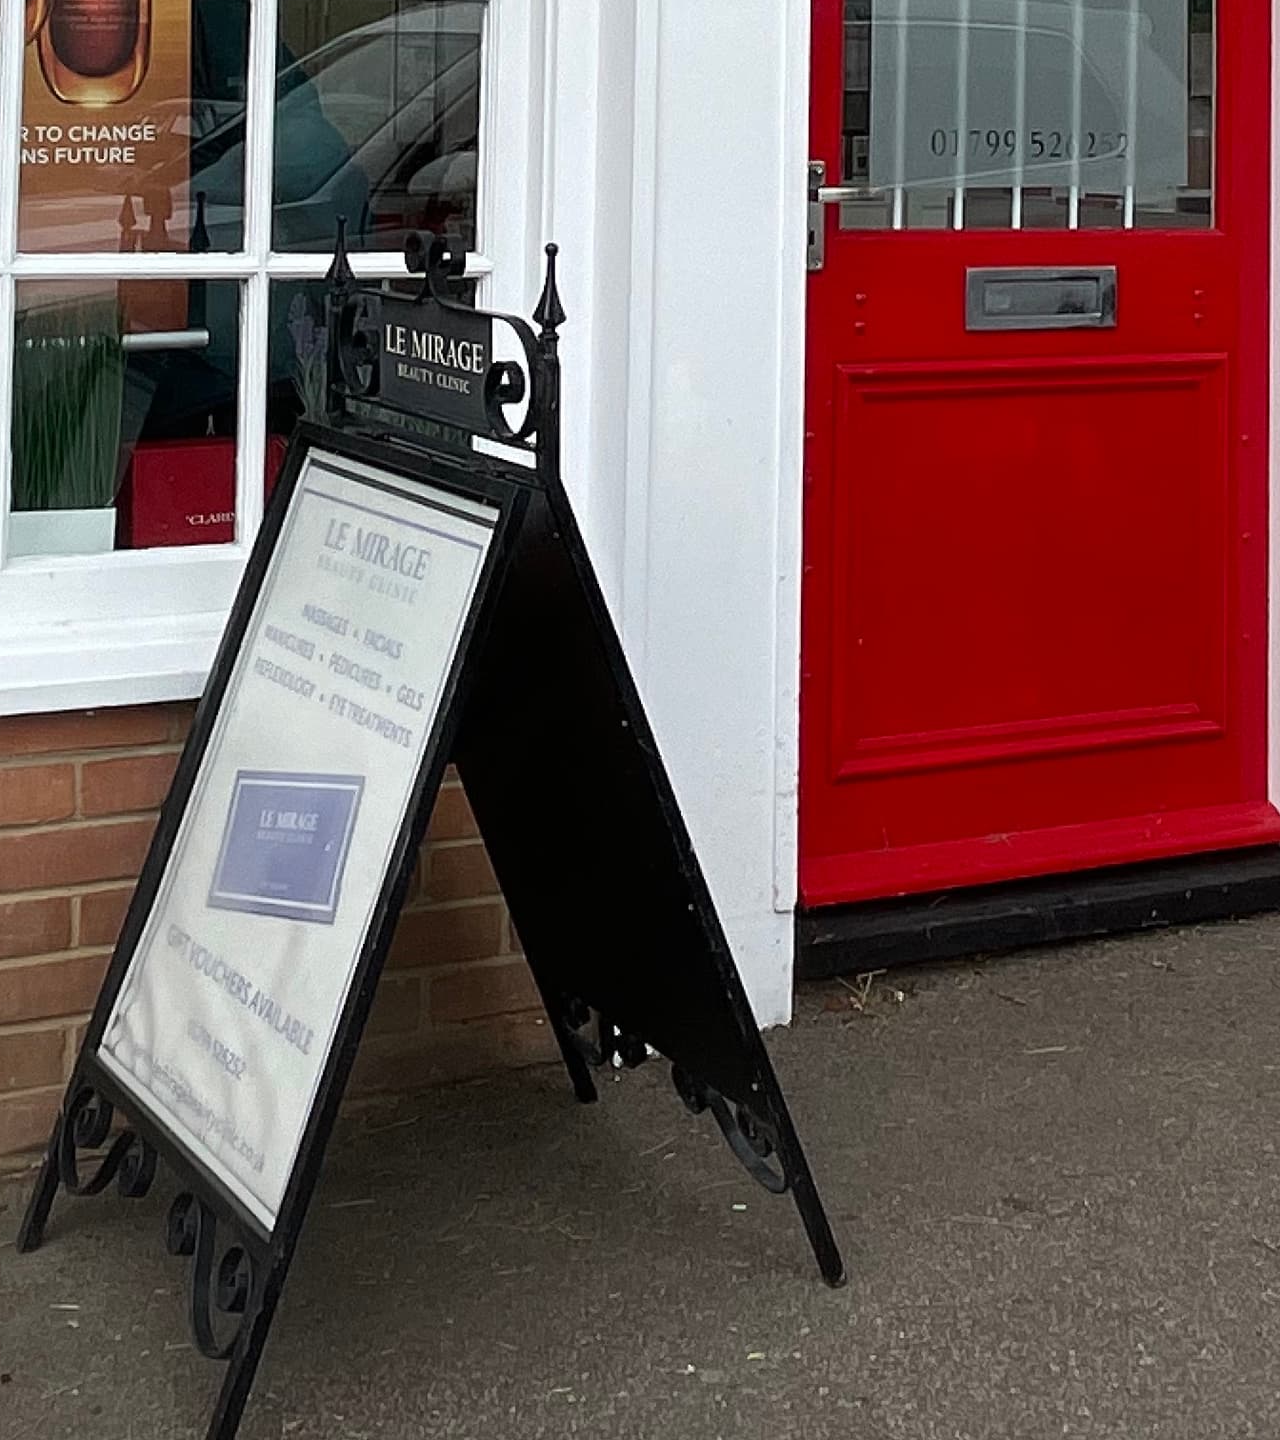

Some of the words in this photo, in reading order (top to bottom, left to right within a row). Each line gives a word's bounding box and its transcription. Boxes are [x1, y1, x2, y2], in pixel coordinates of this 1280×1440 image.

[35, 126, 63, 142] TO
[68, 124, 157, 142] CHANGE
[54, 146, 136, 164] FUTURE
[384, 323, 407, 355] LE
[410, 329, 485, 374] MIRAGE
[397, 361, 434, 385] BEAUTY
[323, 519, 352, 551] LE
[349, 527, 432, 581] MIRAGE
[396, 683, 425, 712] GELS
[188, 946, 253, 1006] VOUCHERS
[248, 989, 315, 1056] AVAILABLE
